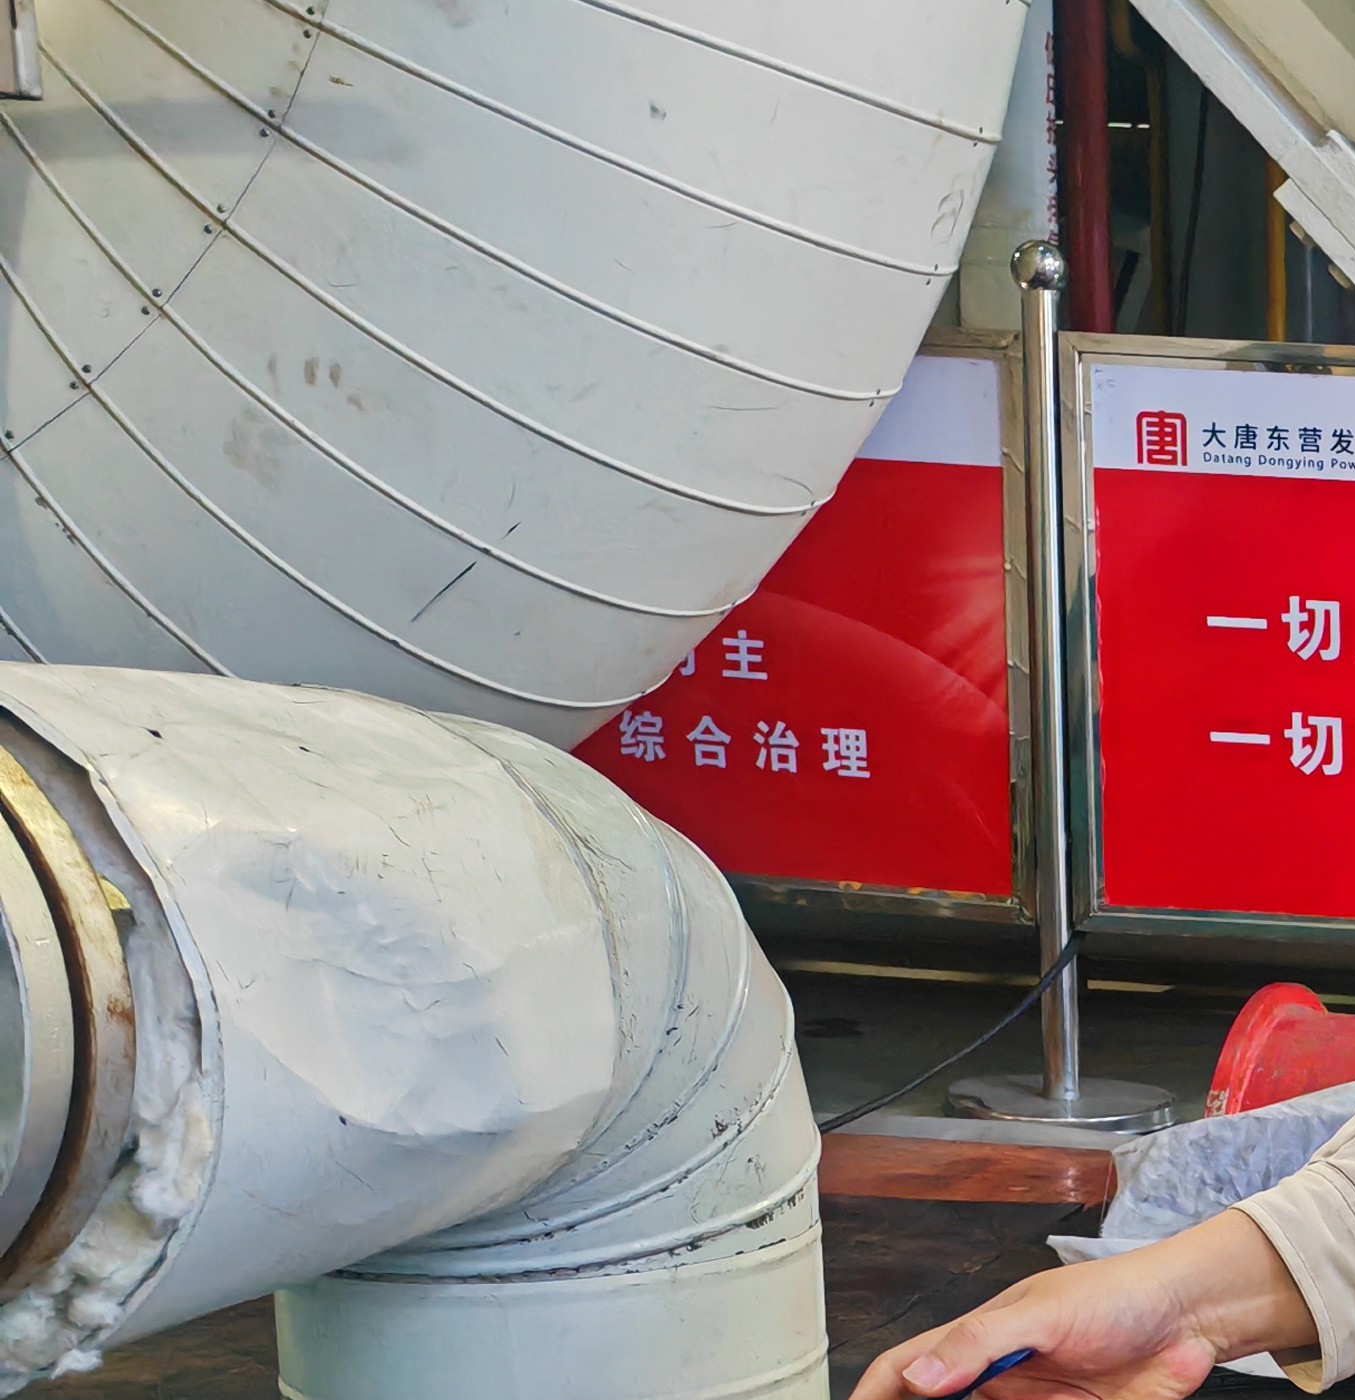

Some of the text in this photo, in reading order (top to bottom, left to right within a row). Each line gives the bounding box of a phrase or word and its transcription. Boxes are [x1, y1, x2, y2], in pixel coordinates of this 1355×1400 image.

[1203, 451, 1252, 468] Datang
[1258, 454, 1324, 471] Dongying
[679, 629, 769, 681] 主
[618, 709, 872, 779] 综合治理
